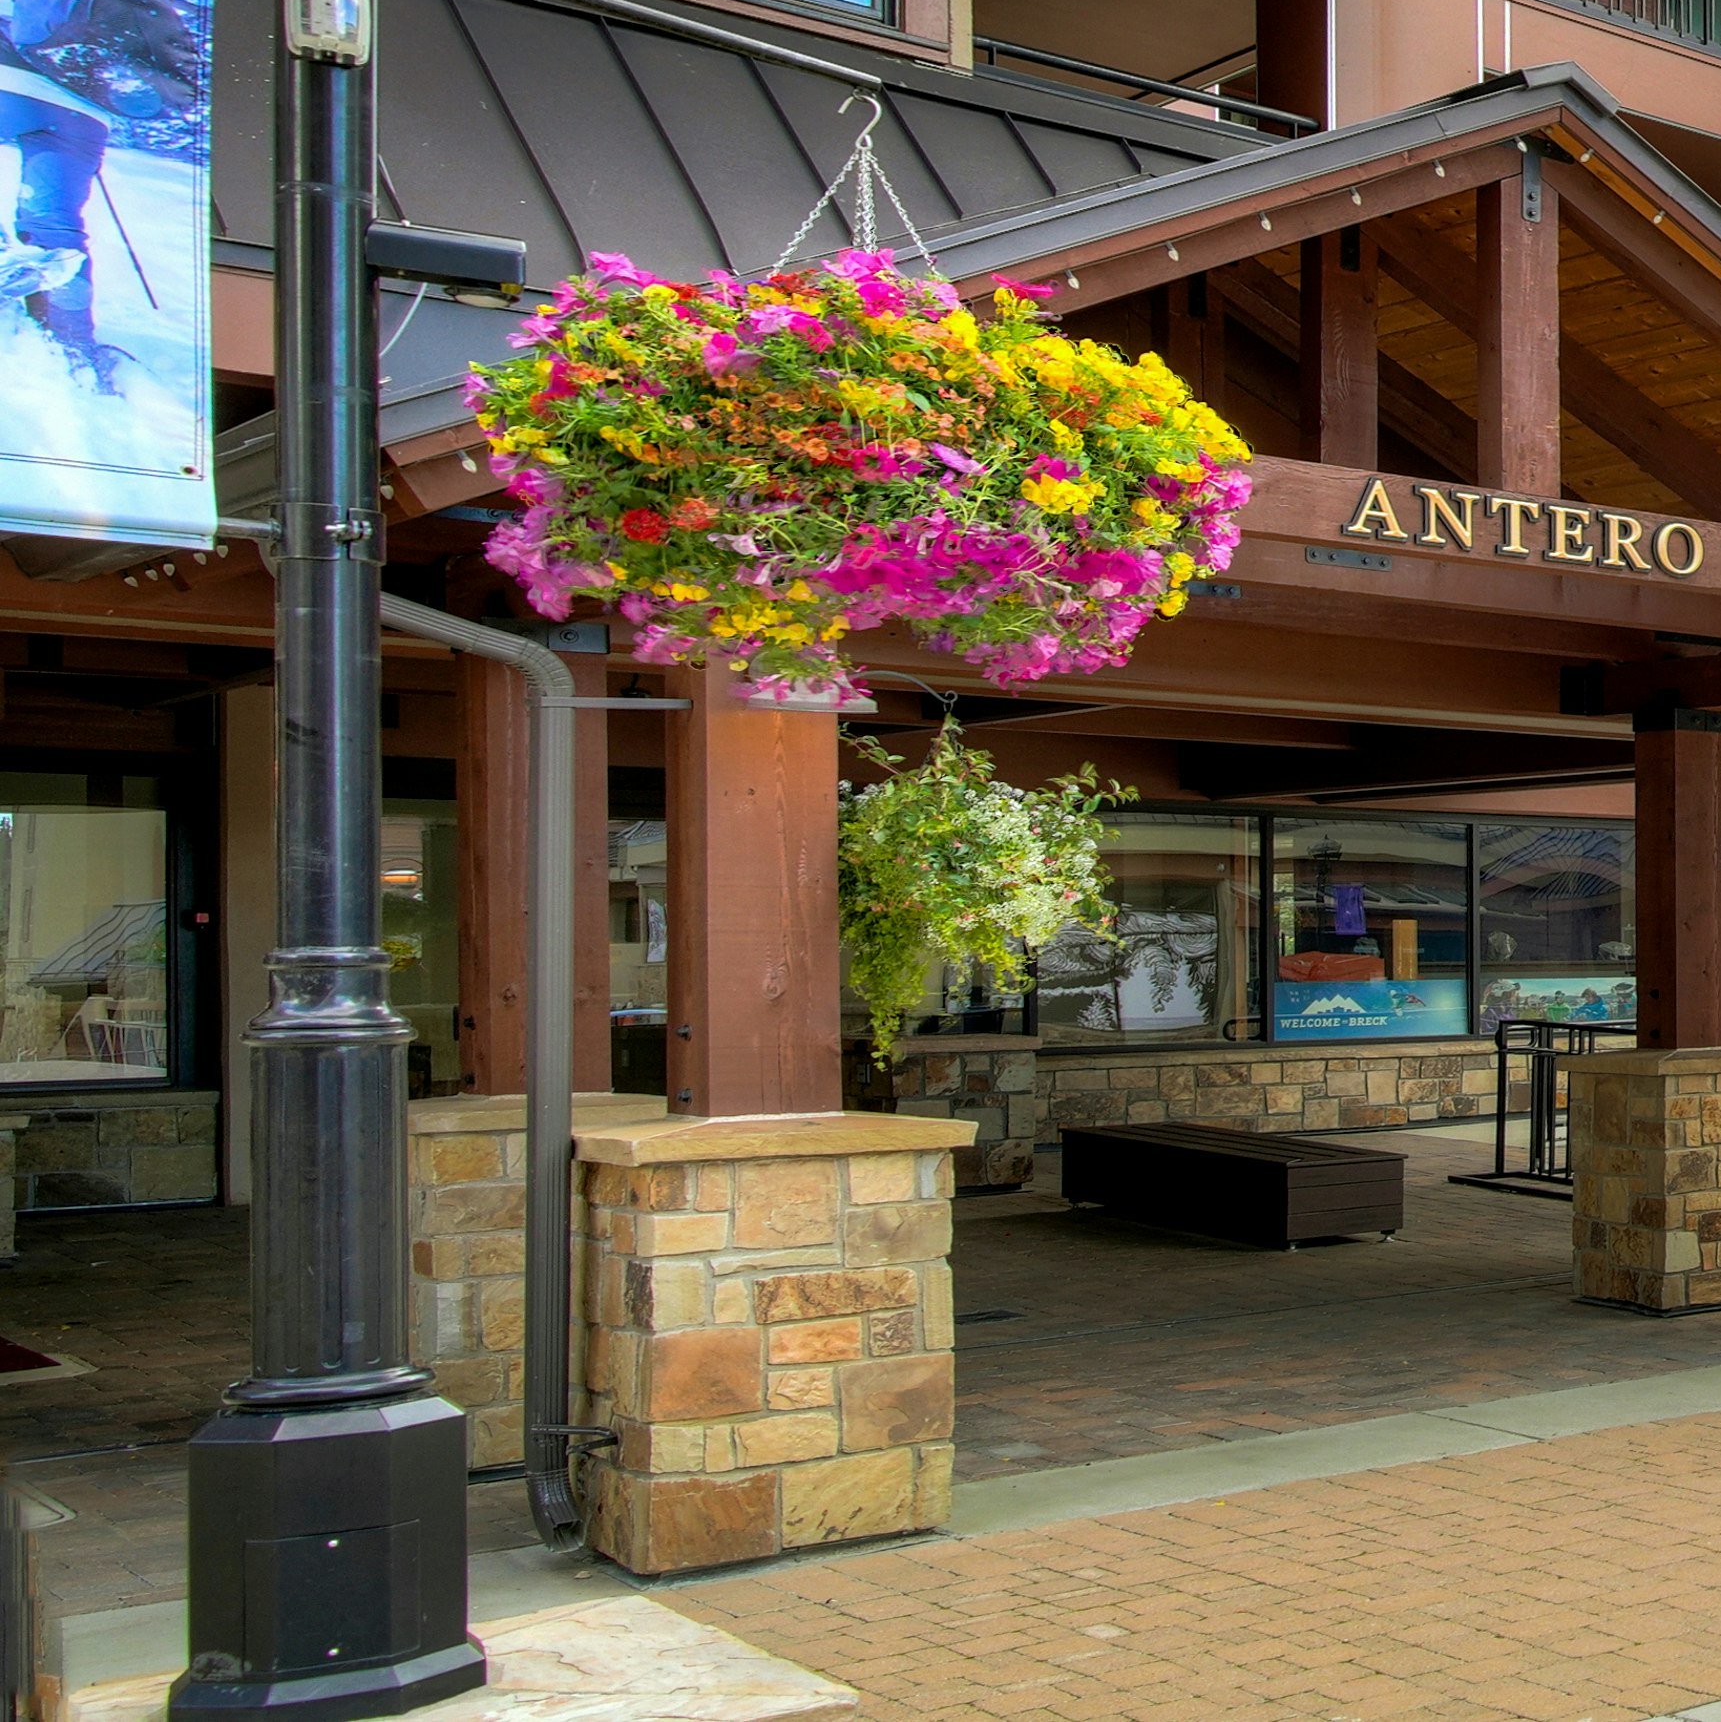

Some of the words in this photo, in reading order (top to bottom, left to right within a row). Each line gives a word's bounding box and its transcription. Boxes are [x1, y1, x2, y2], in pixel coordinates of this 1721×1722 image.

[1341, 477, 1705, 577] ANTERO
[1280, 1017, 1341, 1029] WELCOME
[1349, 1015, 1388, 1027] BRECK
